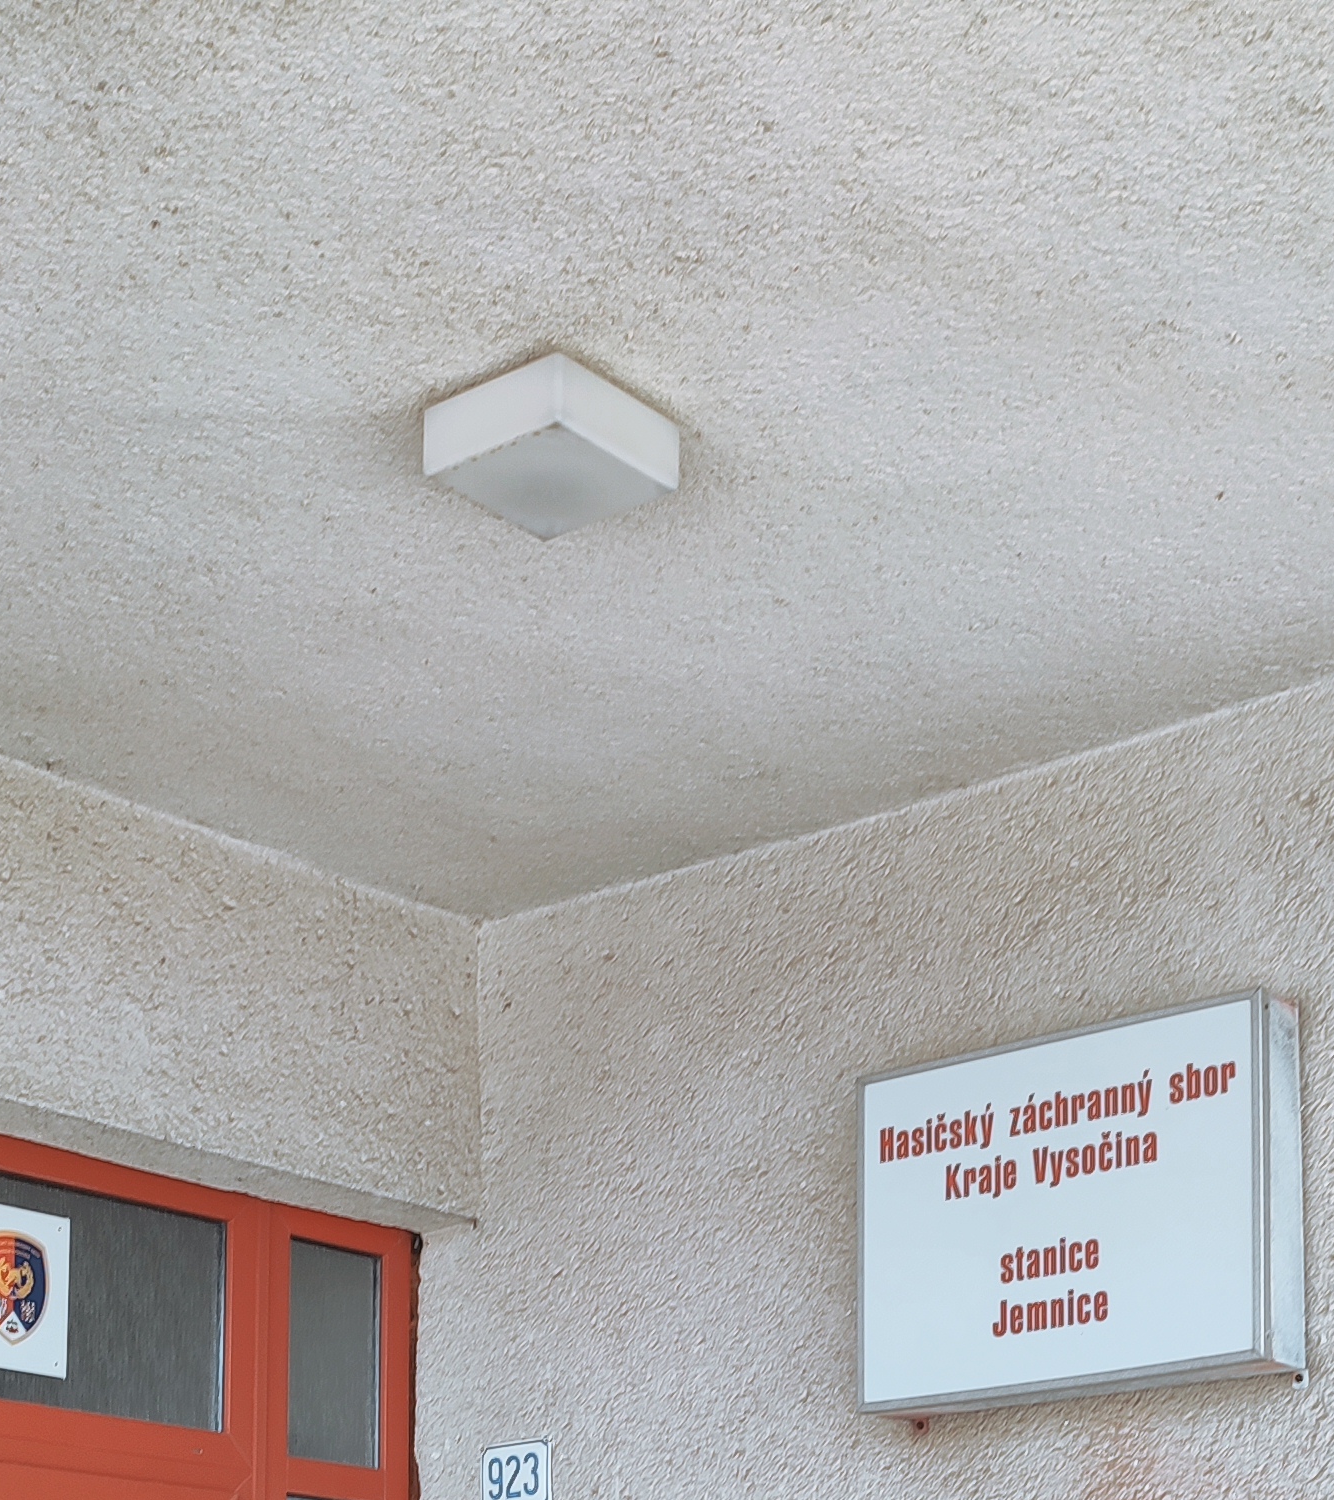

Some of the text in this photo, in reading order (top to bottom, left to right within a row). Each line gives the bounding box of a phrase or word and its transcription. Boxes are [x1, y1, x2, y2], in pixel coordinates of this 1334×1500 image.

[879, 1060, 1236, 1164] Hasičský záchranný sbor
[944, 1131, 1158, 1201] Kraje Vysočina
[1000, 1236, 1100, 1284] stanice
[992, 1288, 1109, 1338] Jemnice
[488, 1452, 539, 1500] 923
